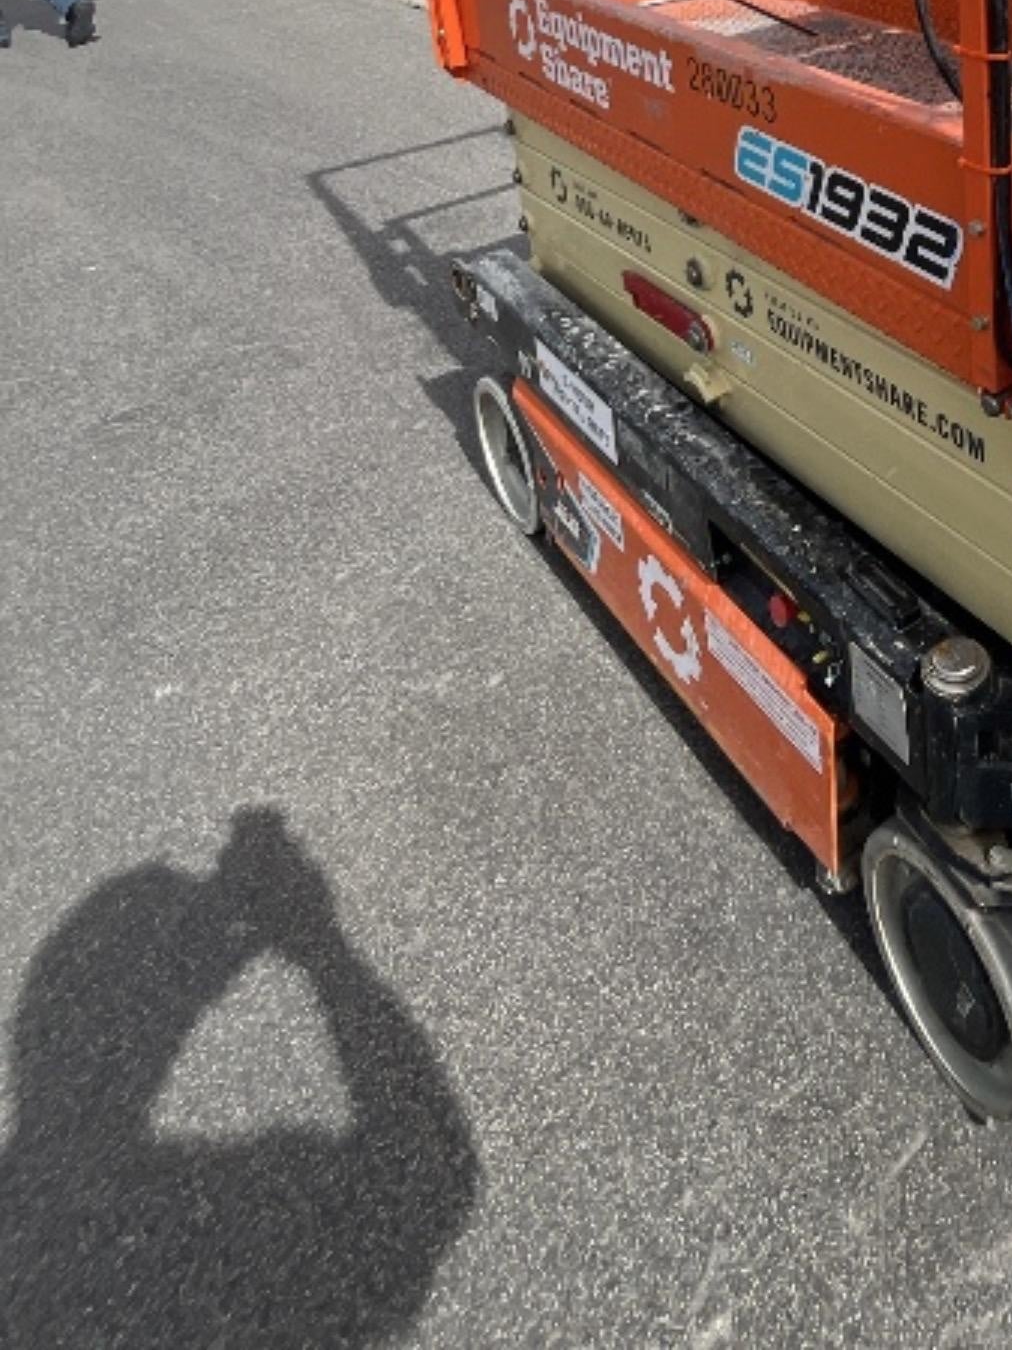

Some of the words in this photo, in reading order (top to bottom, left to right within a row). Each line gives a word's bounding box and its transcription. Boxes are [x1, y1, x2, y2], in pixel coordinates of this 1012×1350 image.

[540, 44, 610, 109] Share
[735, 125, 964, 291] ES1932
[767, 309, 986, 463] EQUIPMENTSHARE.COM
